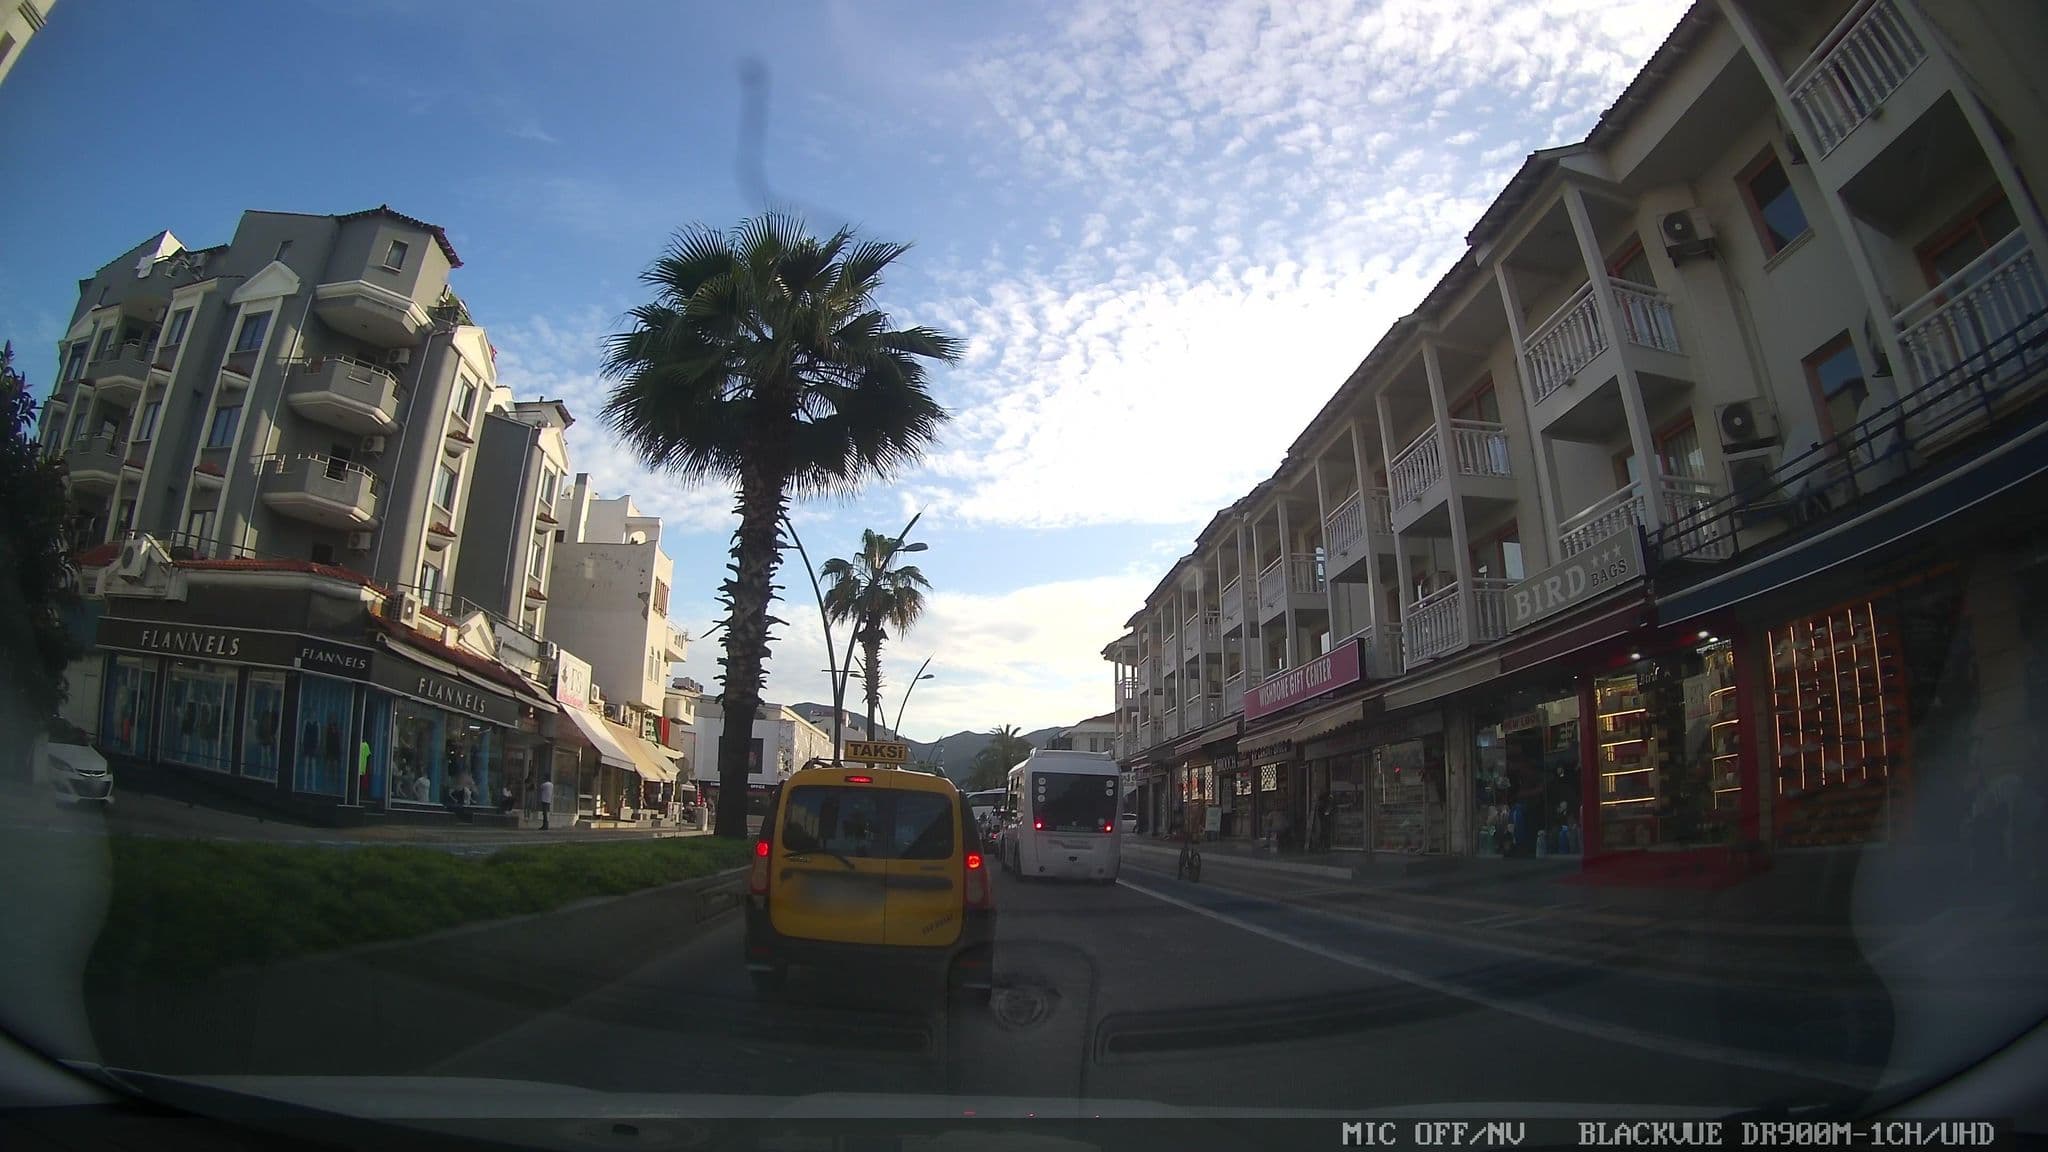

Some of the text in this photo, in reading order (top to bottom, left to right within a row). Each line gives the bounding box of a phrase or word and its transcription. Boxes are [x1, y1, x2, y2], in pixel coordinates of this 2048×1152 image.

[1591, 559, 1628, 587] BAGS
[1513, 564, 1587, 622] BIRD
[141, 630, 240, 656] FLANNELS
[302, 648, 367, 669] FLANNELS
[1289, 669, 1304, 696] GIFT
[1305, 657, 1332, 689] CENTER
[418, 678, 486, 713] FLANNELS
